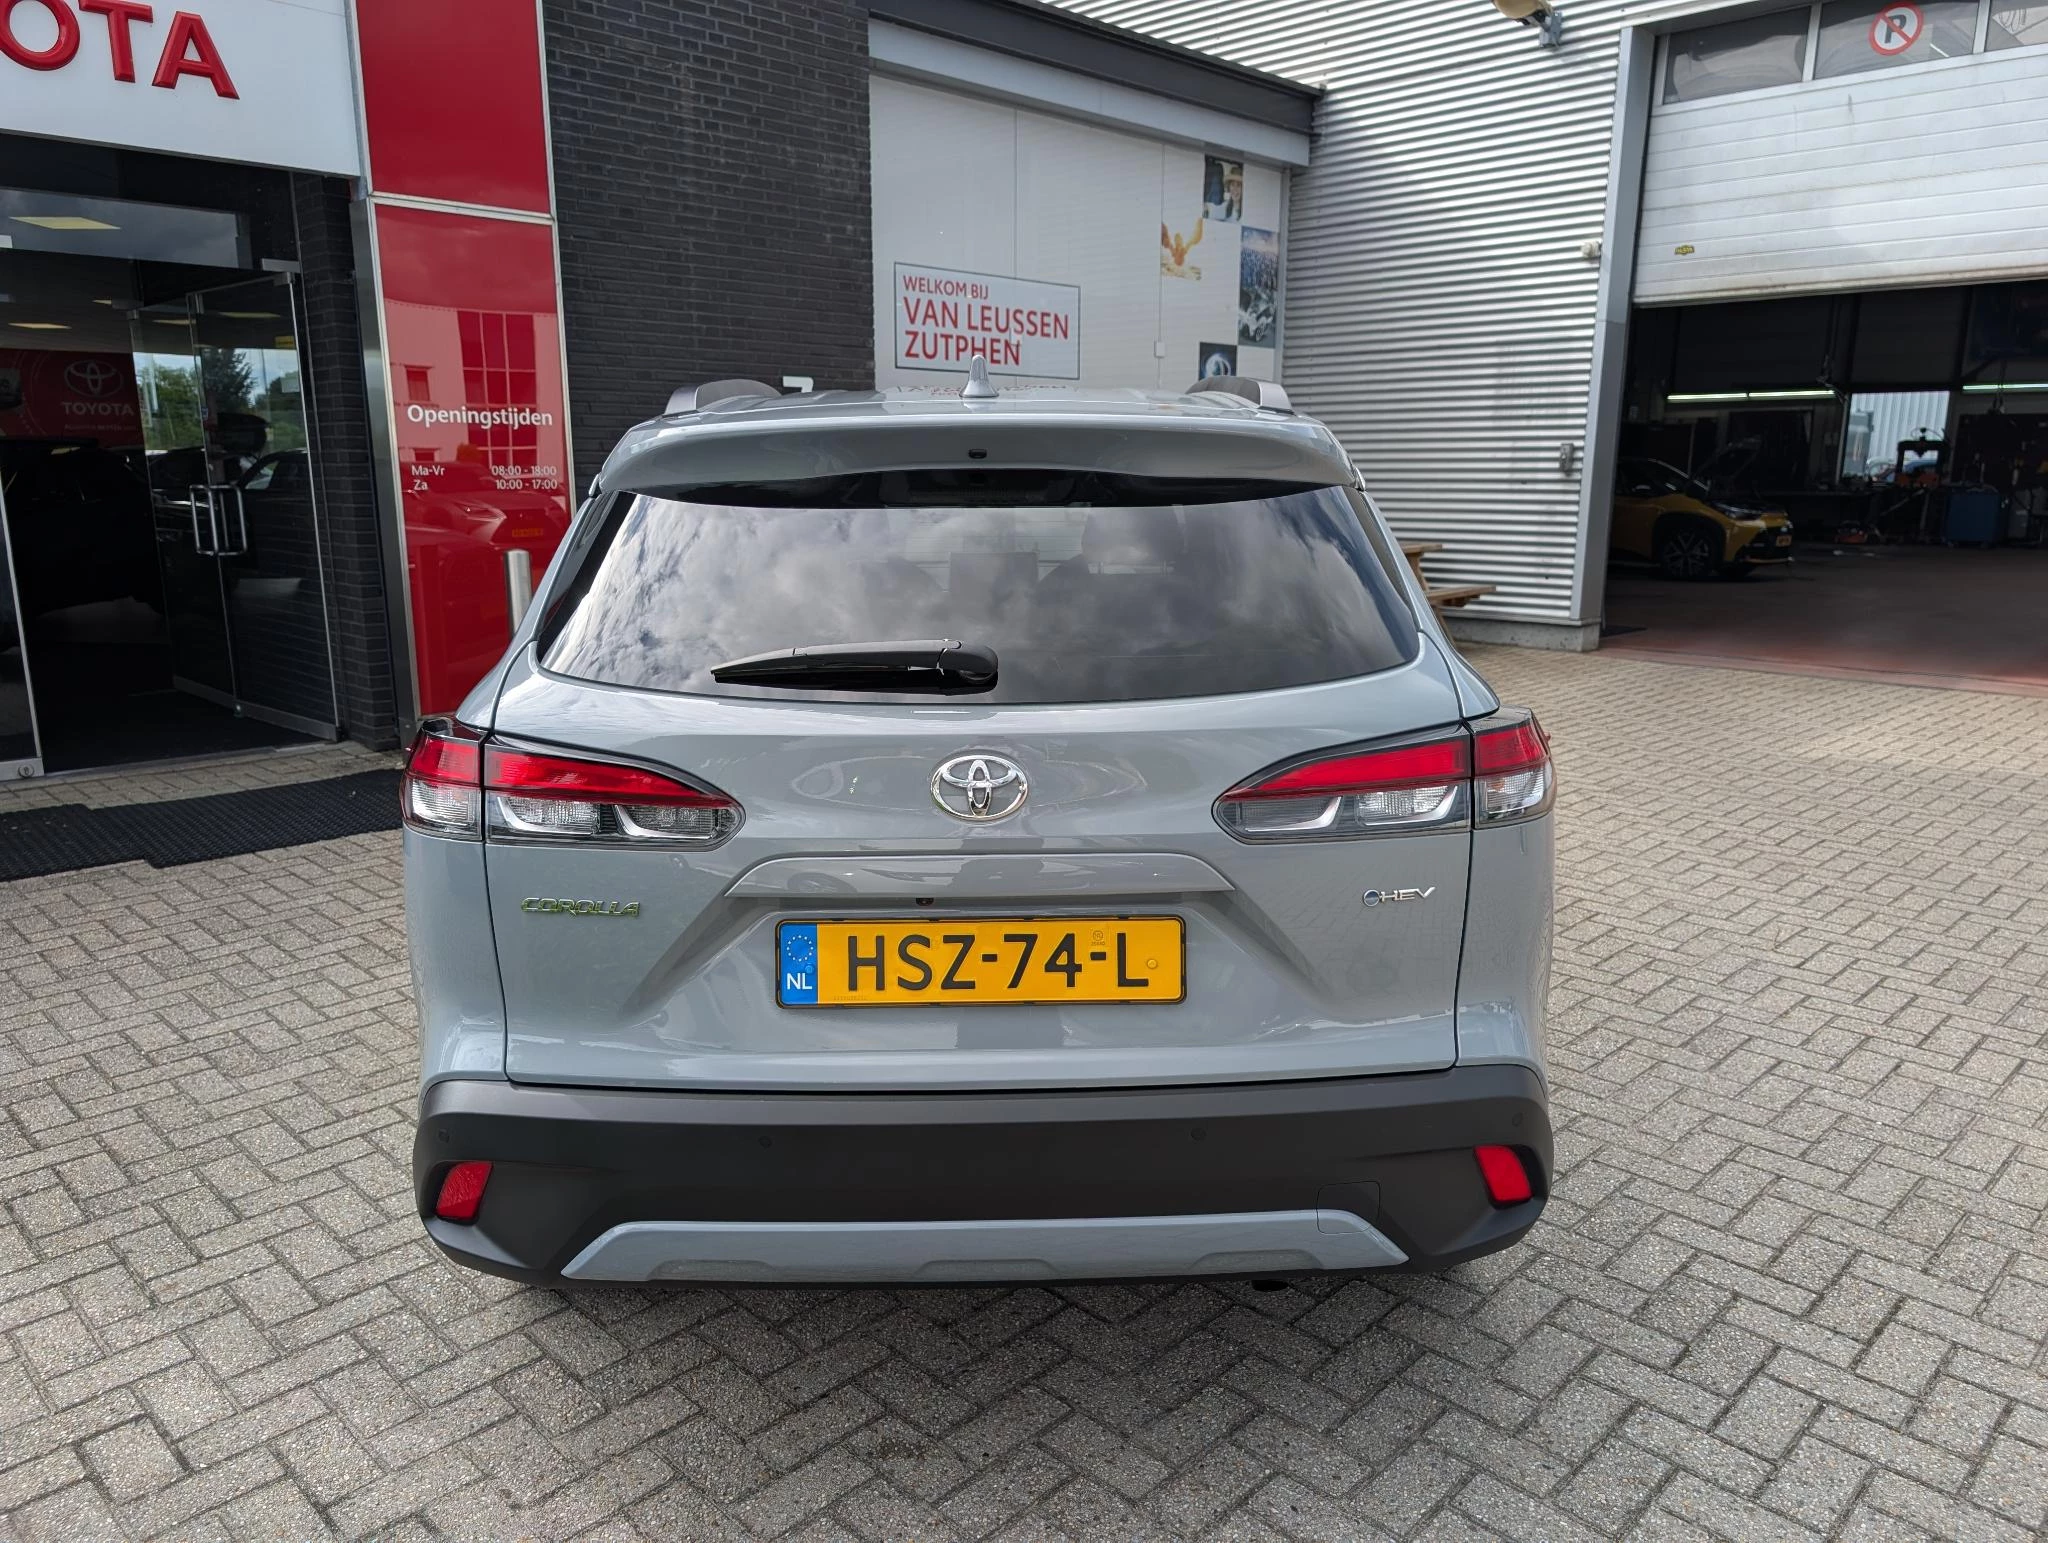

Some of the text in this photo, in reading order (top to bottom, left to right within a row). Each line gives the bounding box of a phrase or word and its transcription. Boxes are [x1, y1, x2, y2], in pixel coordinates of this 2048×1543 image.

[903, 275, 989, 300] WELKOM BIJ
[903, 297, 1069, 340] VAN LEUSSEN
[904, 330, 1021, 366] ZUTPHEN
[61, 402, 135, 416] TOYOTA
[407, 404, 553, 429] Openingstijden
[411, 465, 446, 476] Ma-Vr
[491, 465, 522, 476] 08:00
[531, 465, 557, 476] 18:00
[413, 479, 429, 490] Za
[495, 479, 523, 490] 10:00
[532, 479, 558, 489] 17:00
[520, 897, 640, 917] COROLLA
[848, 932, 1149, 991] HSZ-74-L
[786, 973, 813, 990] NL
